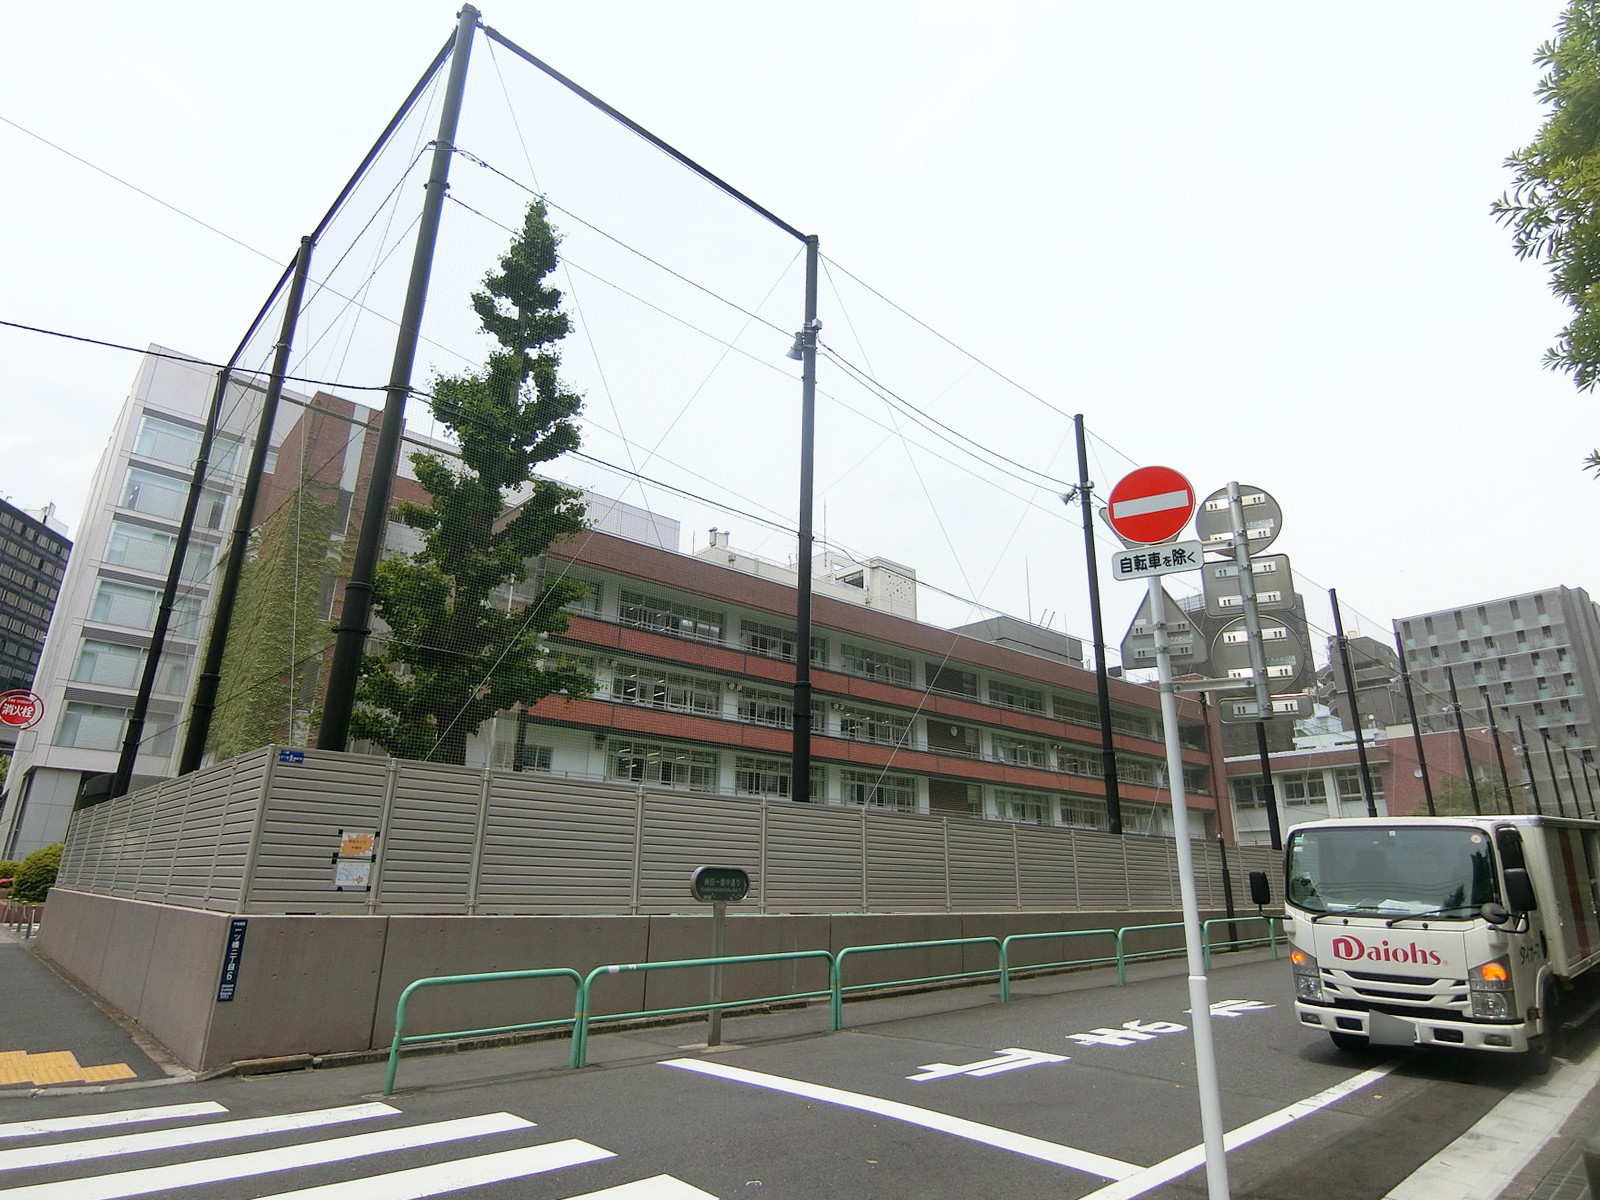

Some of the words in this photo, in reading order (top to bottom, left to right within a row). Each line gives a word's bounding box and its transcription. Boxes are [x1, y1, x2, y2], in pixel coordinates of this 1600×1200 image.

[1120, 548, 1197, 574] 自転車を除く
[2, 703, 34, 718] 消火栓
[1332, 935, 1441, 965] Daiohs
